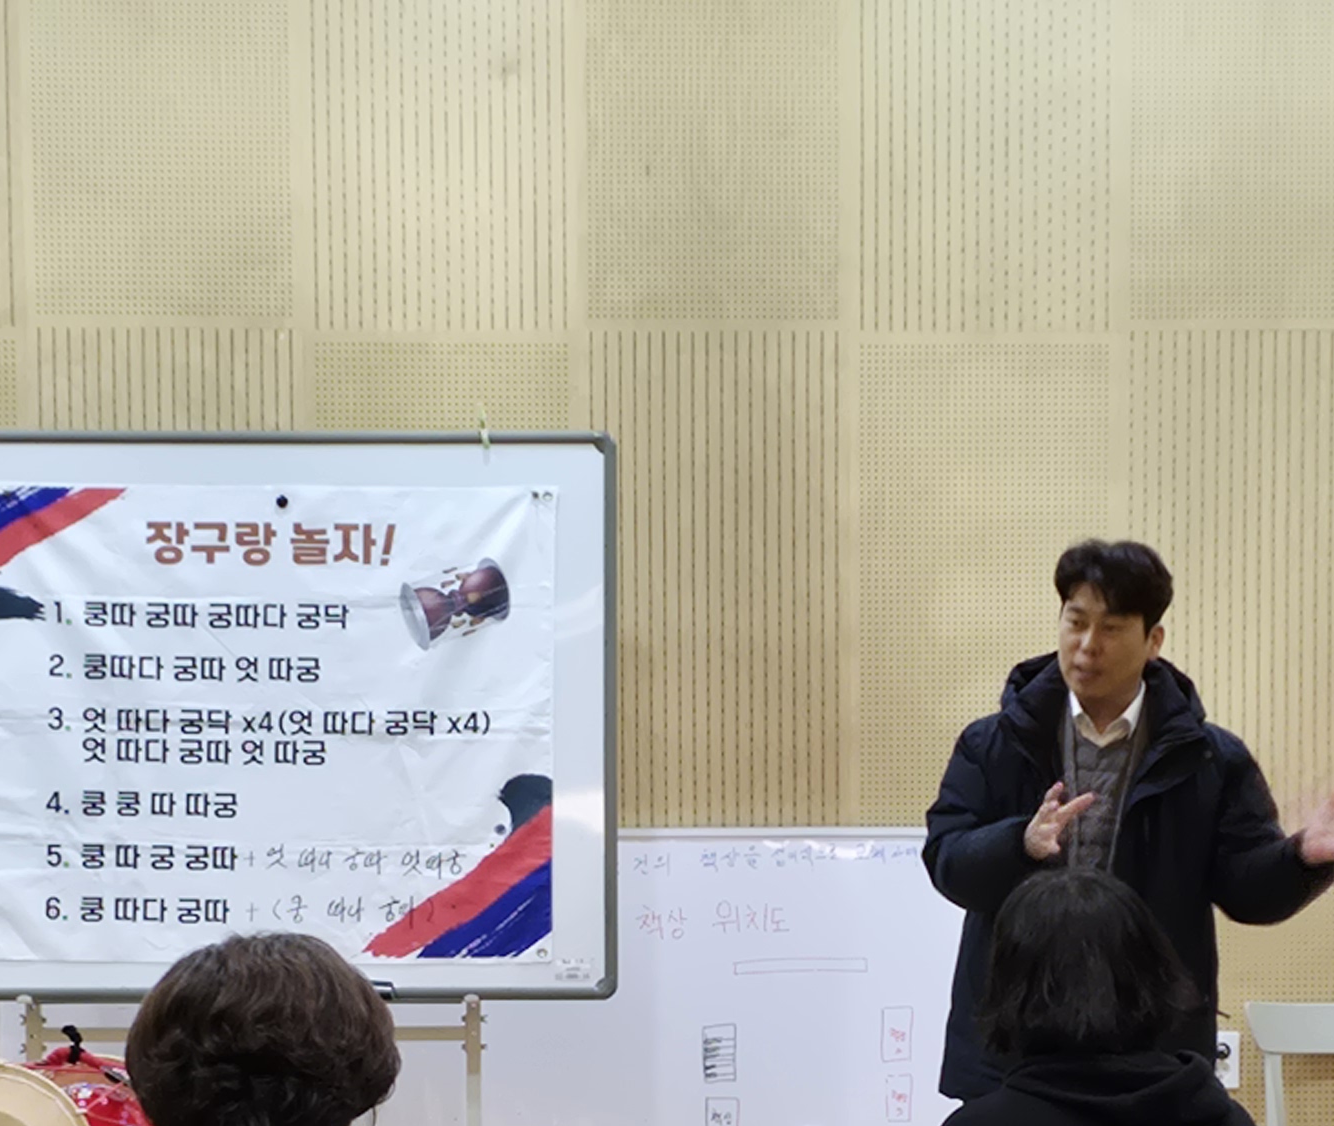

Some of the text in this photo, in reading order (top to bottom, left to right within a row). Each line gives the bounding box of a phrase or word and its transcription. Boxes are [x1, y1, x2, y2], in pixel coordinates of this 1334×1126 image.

[146, 521, 397, 566] 장구랑 놀자!
[53, 601, 350, 630] 1. 쿵따 궁따 궁따다 궁닥
[49, 653, 321, 684] 2. 쿵따다 궁따 엇 따궁
[48, 707, 71, 731] 3.
[82, 707, 107, 733] 엇
[116, 708, 170, 734] 따다
[179, 708, 232, 735] 궁닥
[323, 711, 376, 736] 따다
[385, 711, 438, 737] 궁닥
[446, 711, 492, 736] x4)
[82, 737, 327, 766] 엇 따다 궁따 엇 따궁
[46, 790, 239, 819] 4. 쿵 쿵 따 따궁
[46, 843, 239, 872] 5. 쿵 따 궁 궁따
[45, 896, 231, 924] 6. 쿵 따다 궁따
[636, 899, 791, 941] 책상 위치도
